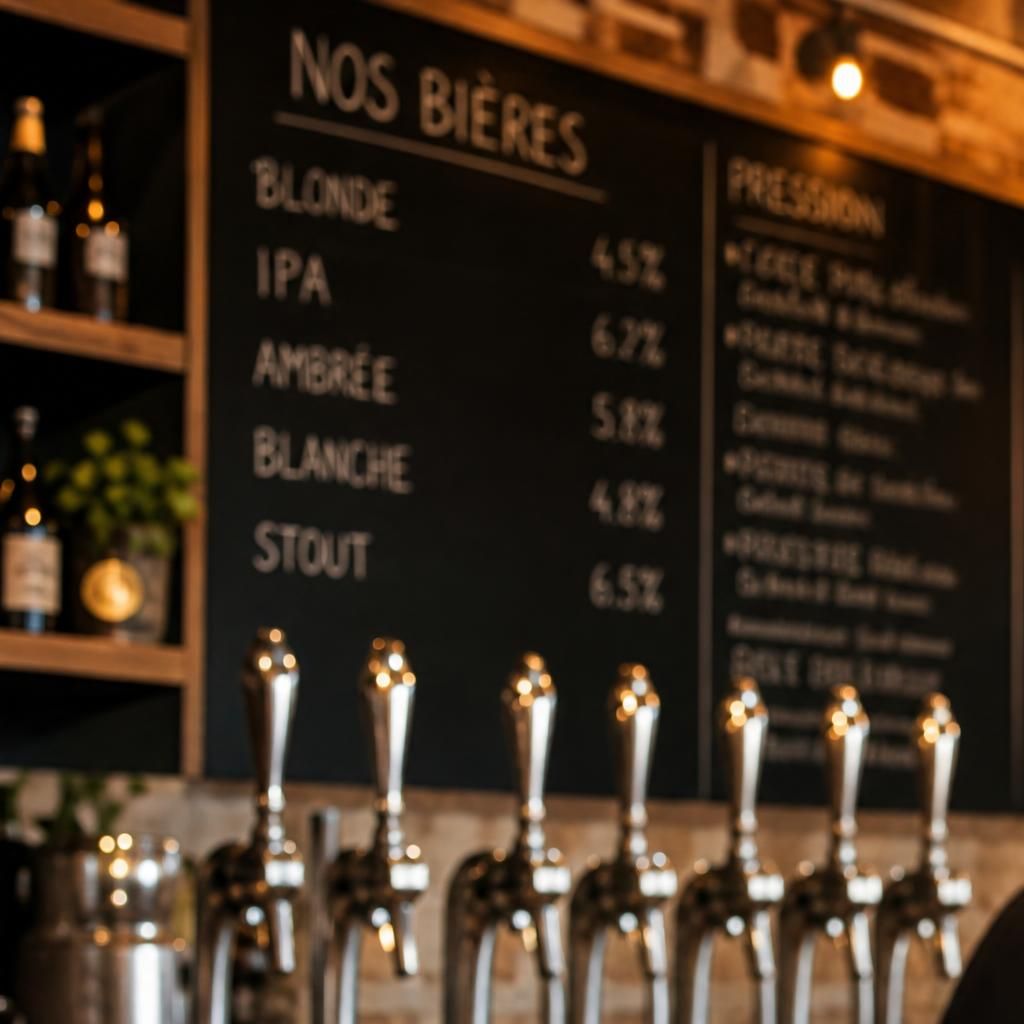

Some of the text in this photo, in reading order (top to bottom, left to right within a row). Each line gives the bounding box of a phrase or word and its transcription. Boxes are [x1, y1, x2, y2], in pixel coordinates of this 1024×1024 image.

[289, 27, 588, 175] NOS BIÈRES
[253, 156, 398, 231] BLONDE
[256, 247, 332, 304] IPA
[252, 338, 396, 405] AMBRÉE
[253, 425, 412, 495] BLANCHE
[253, 520, 372, 580] STOUT
